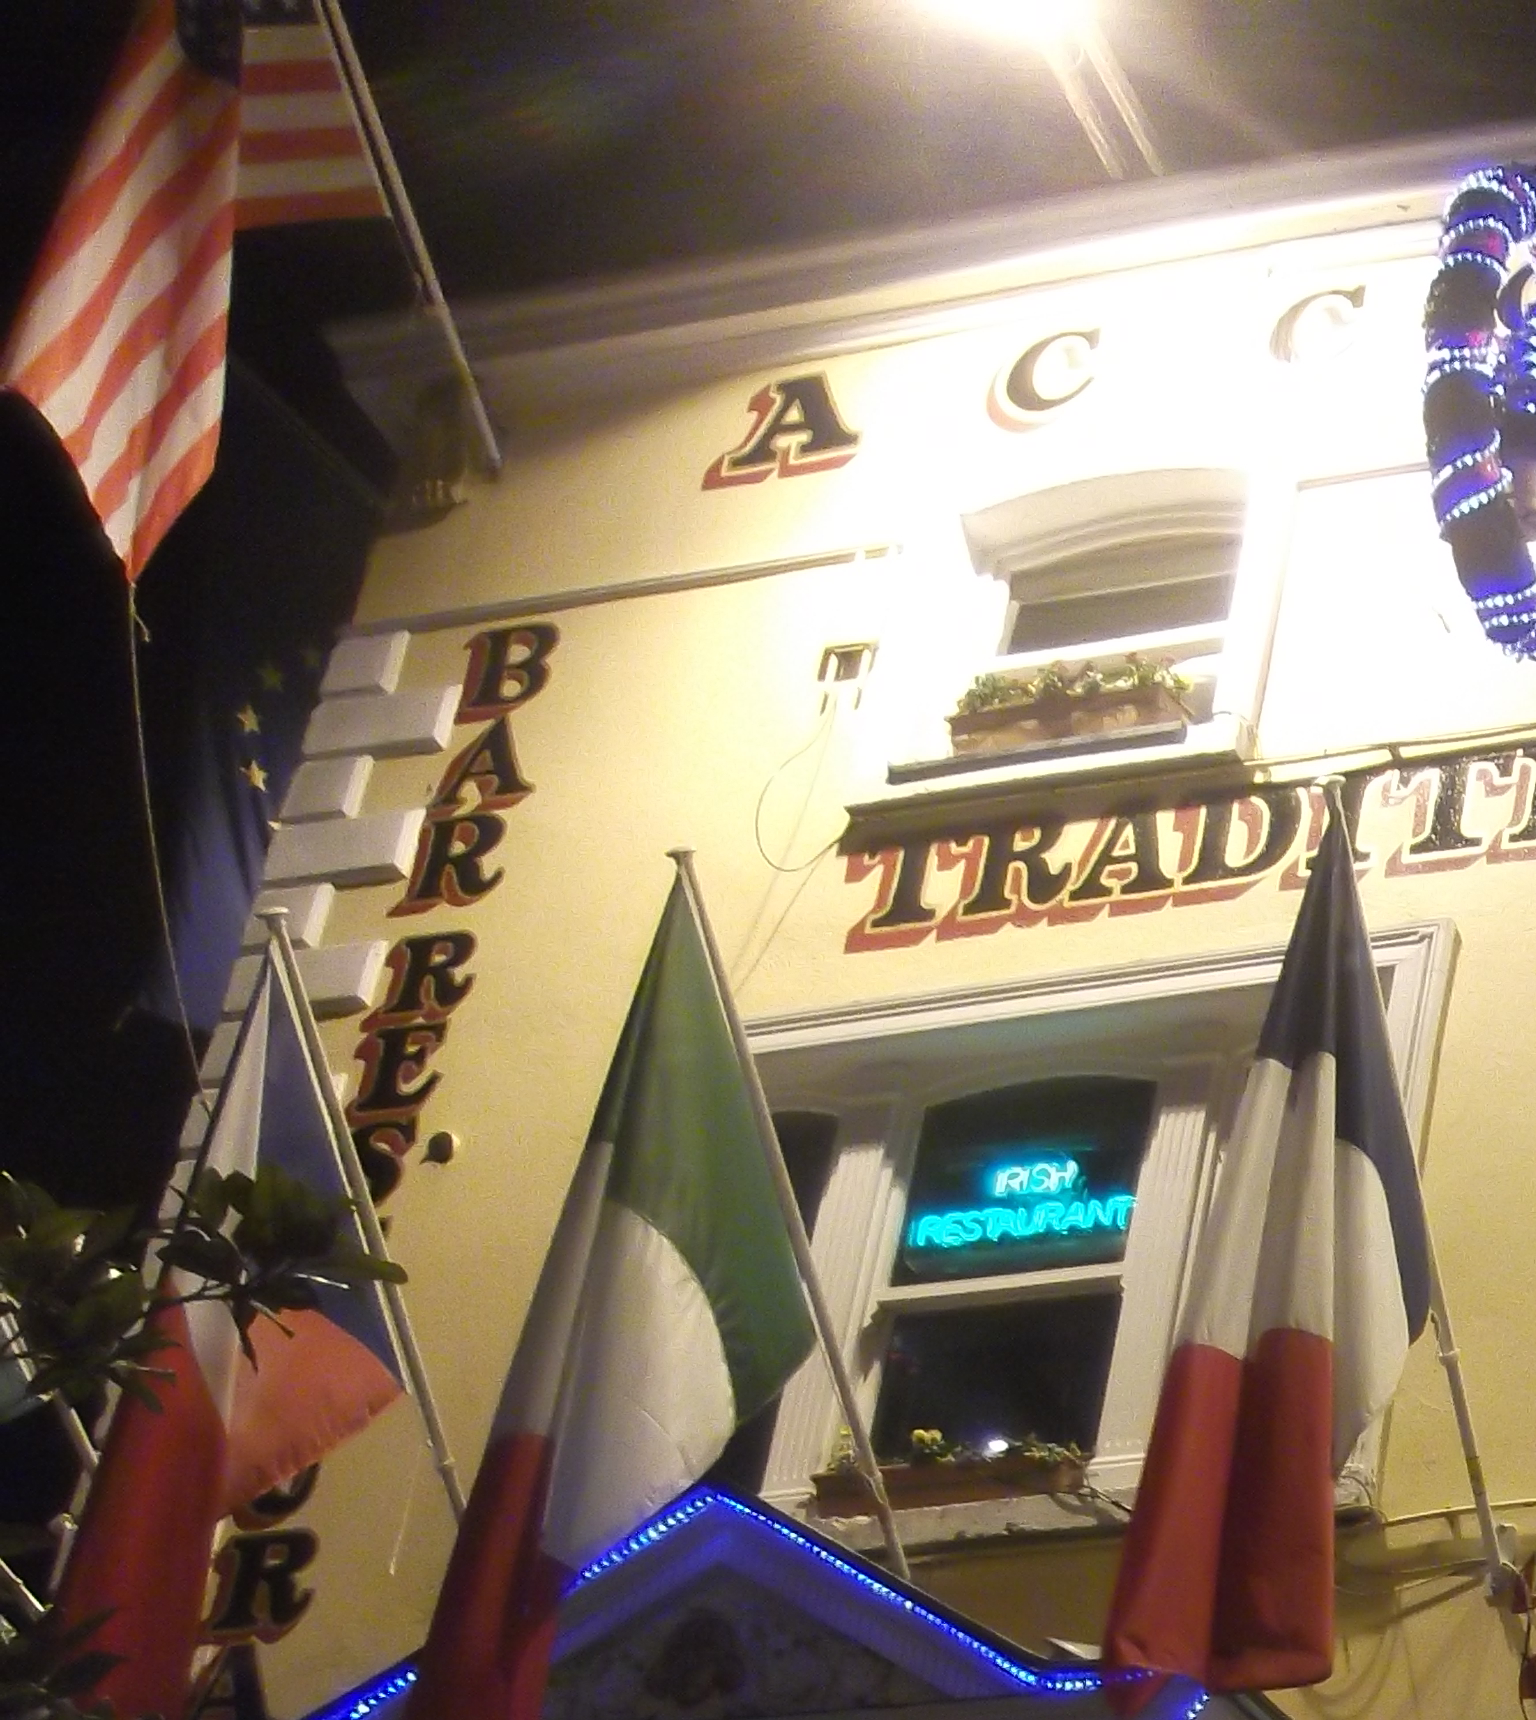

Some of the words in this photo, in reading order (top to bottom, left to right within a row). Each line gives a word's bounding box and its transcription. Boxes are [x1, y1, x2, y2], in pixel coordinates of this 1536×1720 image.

[387, 622, 561, 918] BAR
[993, 1158, 1080, 1198] IRISH
[914, 1195, 1139, 1248] RESTAURANT
